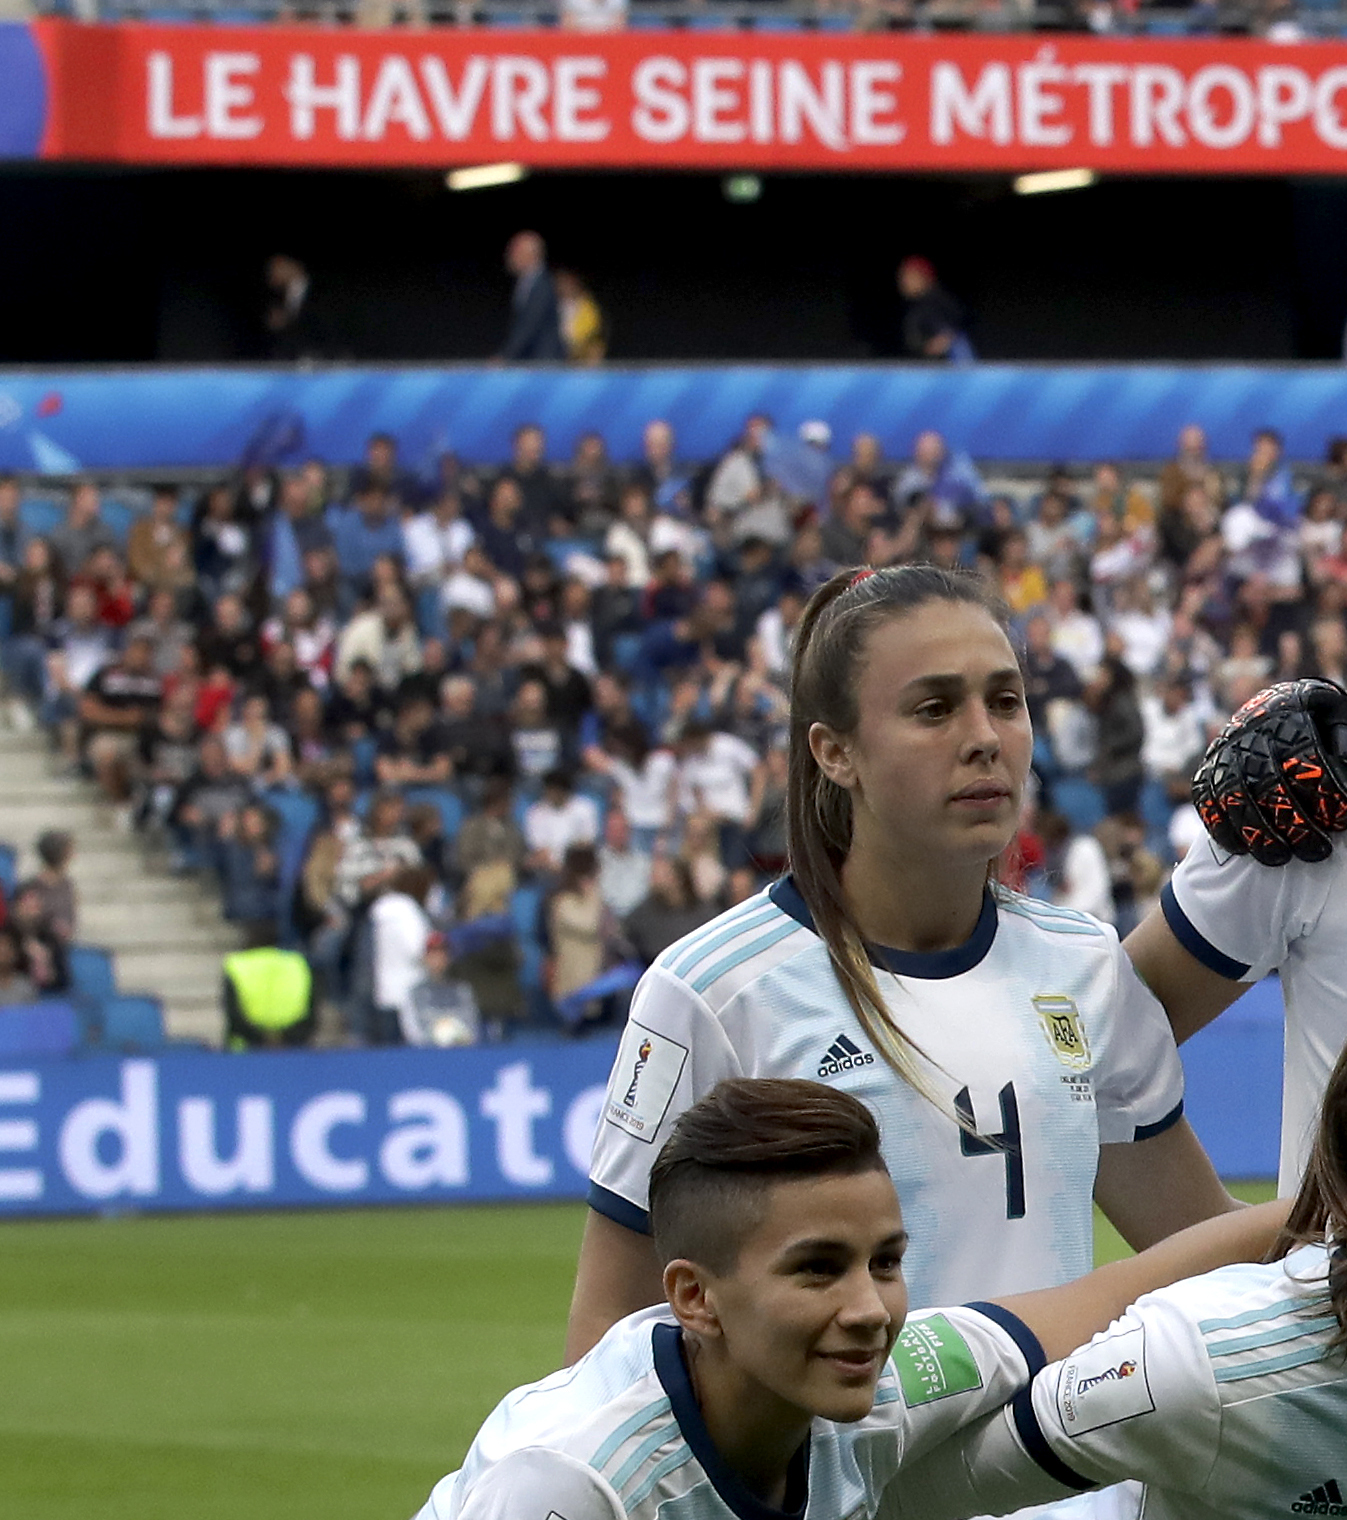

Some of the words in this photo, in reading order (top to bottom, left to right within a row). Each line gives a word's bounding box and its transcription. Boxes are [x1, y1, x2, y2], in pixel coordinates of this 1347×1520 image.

[146, 51, 264, 139] LE
[285, 53, 610, 143] HAVRE
[631, 56, 906, 150] SEINE
[817, 1050, 875, 1077] adidas
[955, 1080, 1026, 1219] 4
